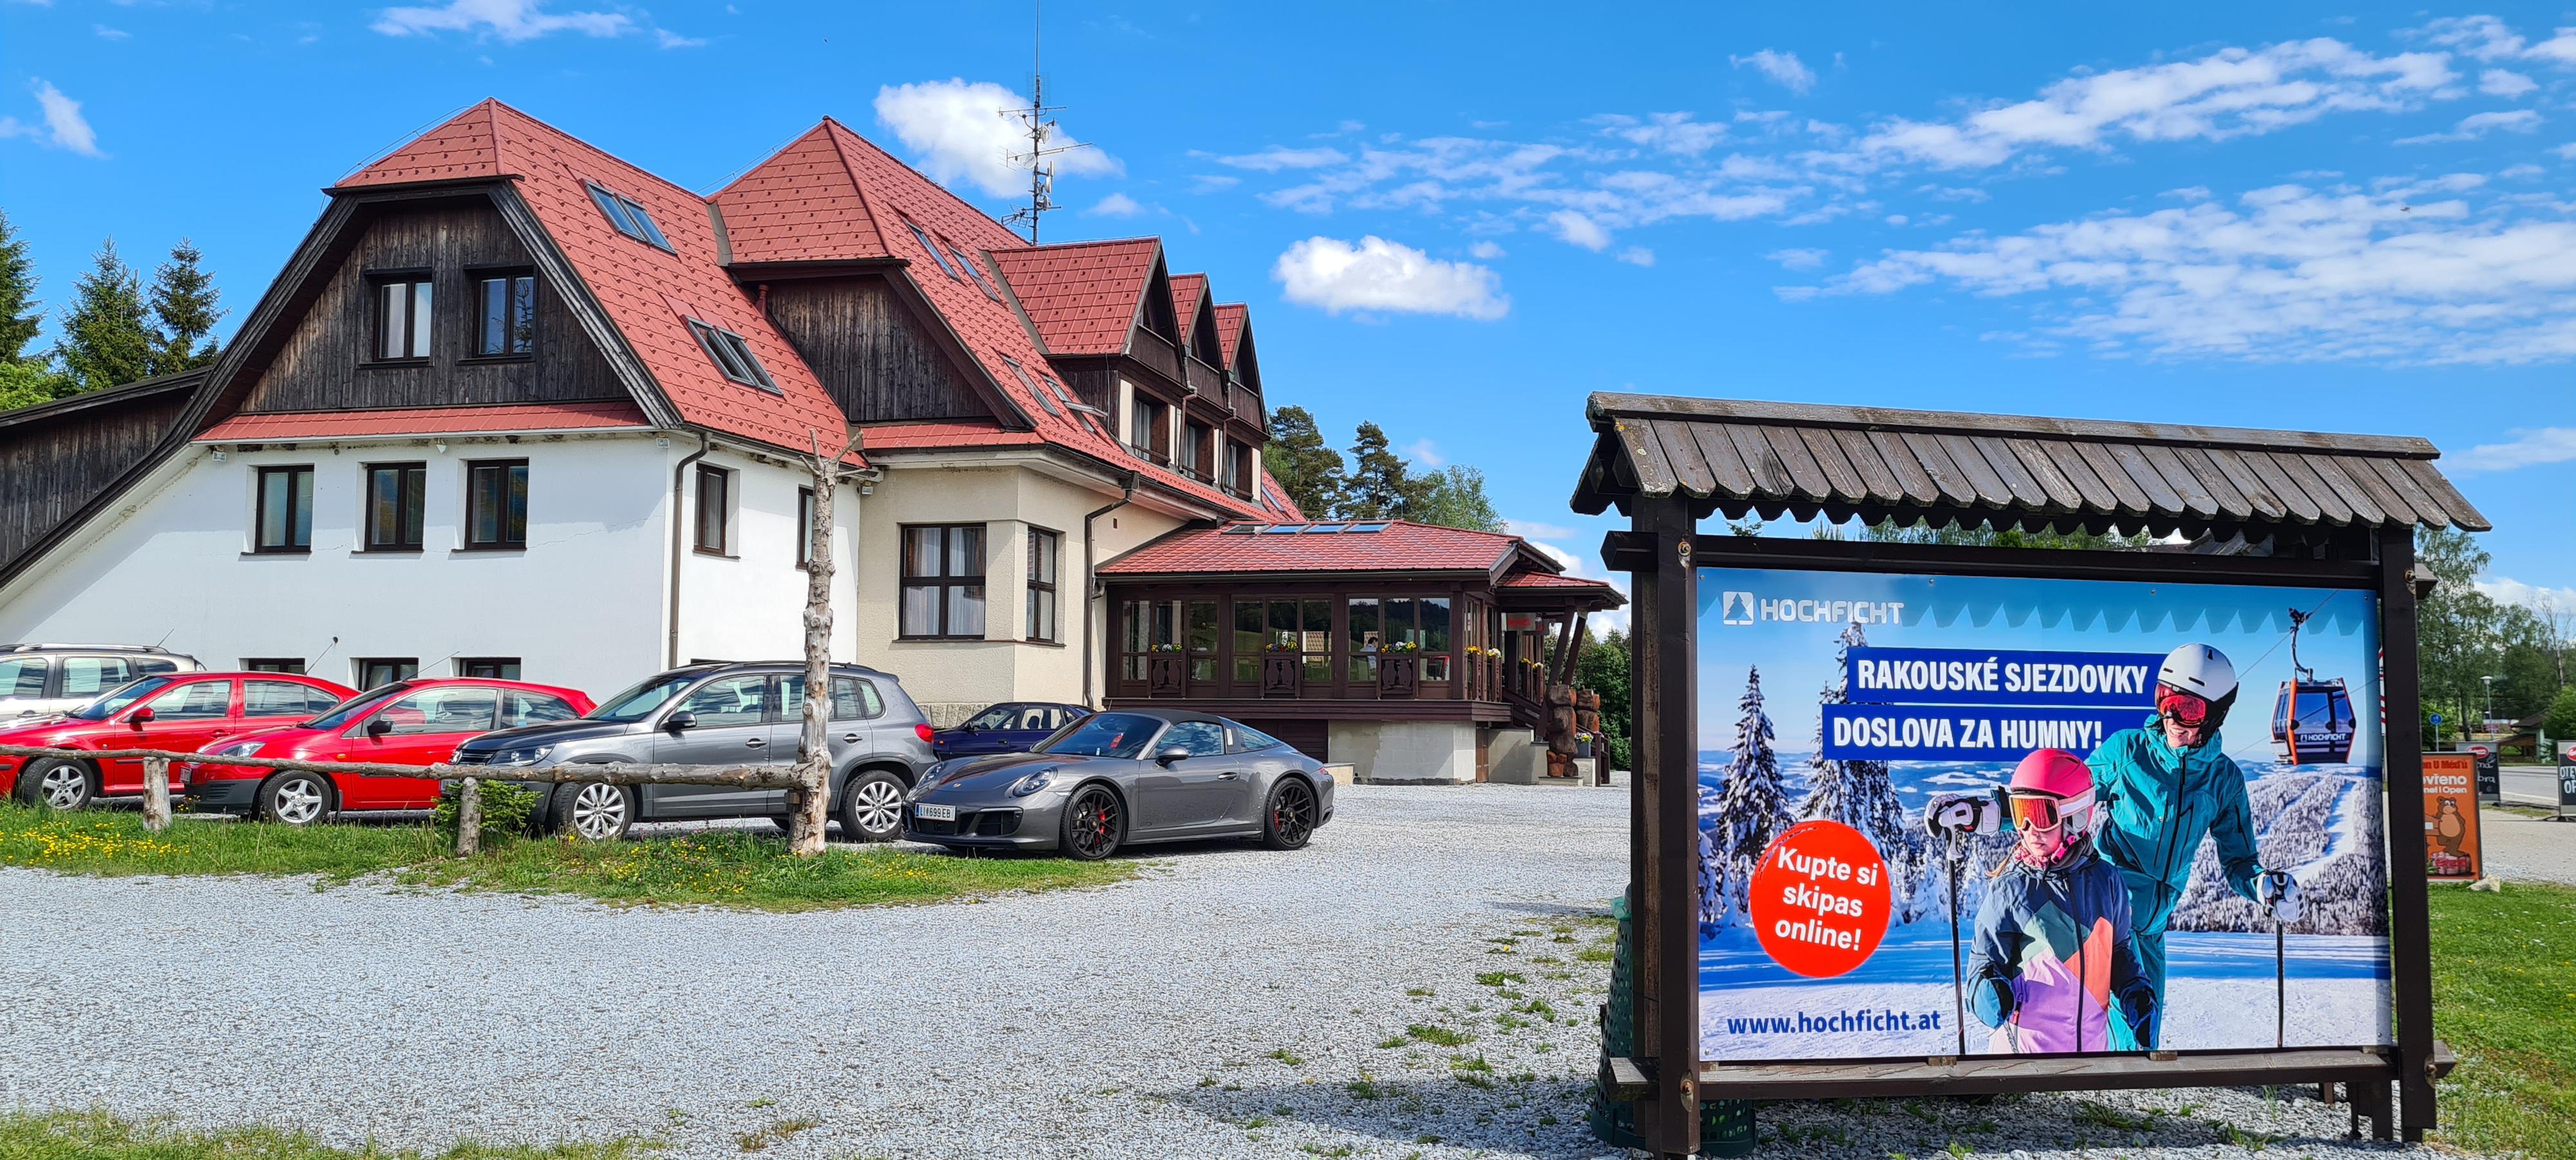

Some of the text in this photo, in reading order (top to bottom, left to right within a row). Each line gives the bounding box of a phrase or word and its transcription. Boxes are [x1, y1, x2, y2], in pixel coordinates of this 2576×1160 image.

[1760, 598, 1904, 624] HOCHFICHT
[1858, 656, 2148, 694] RAKOUSKÉ SJEZDOVKY
[1833, 717, 2102, 749] DOSLOVA ZA HUMNY!
[2560, 766, 2576, 778] OTE
[2442, 786, 2467, 794] Open
[1777, 846, 1879, 886] Kupte si
[1782, 882, 1863, 917] skipas
[1775, 918, 1862, 951] online!
[1727, 1009, 1941, 1034] www.hochficht.at
